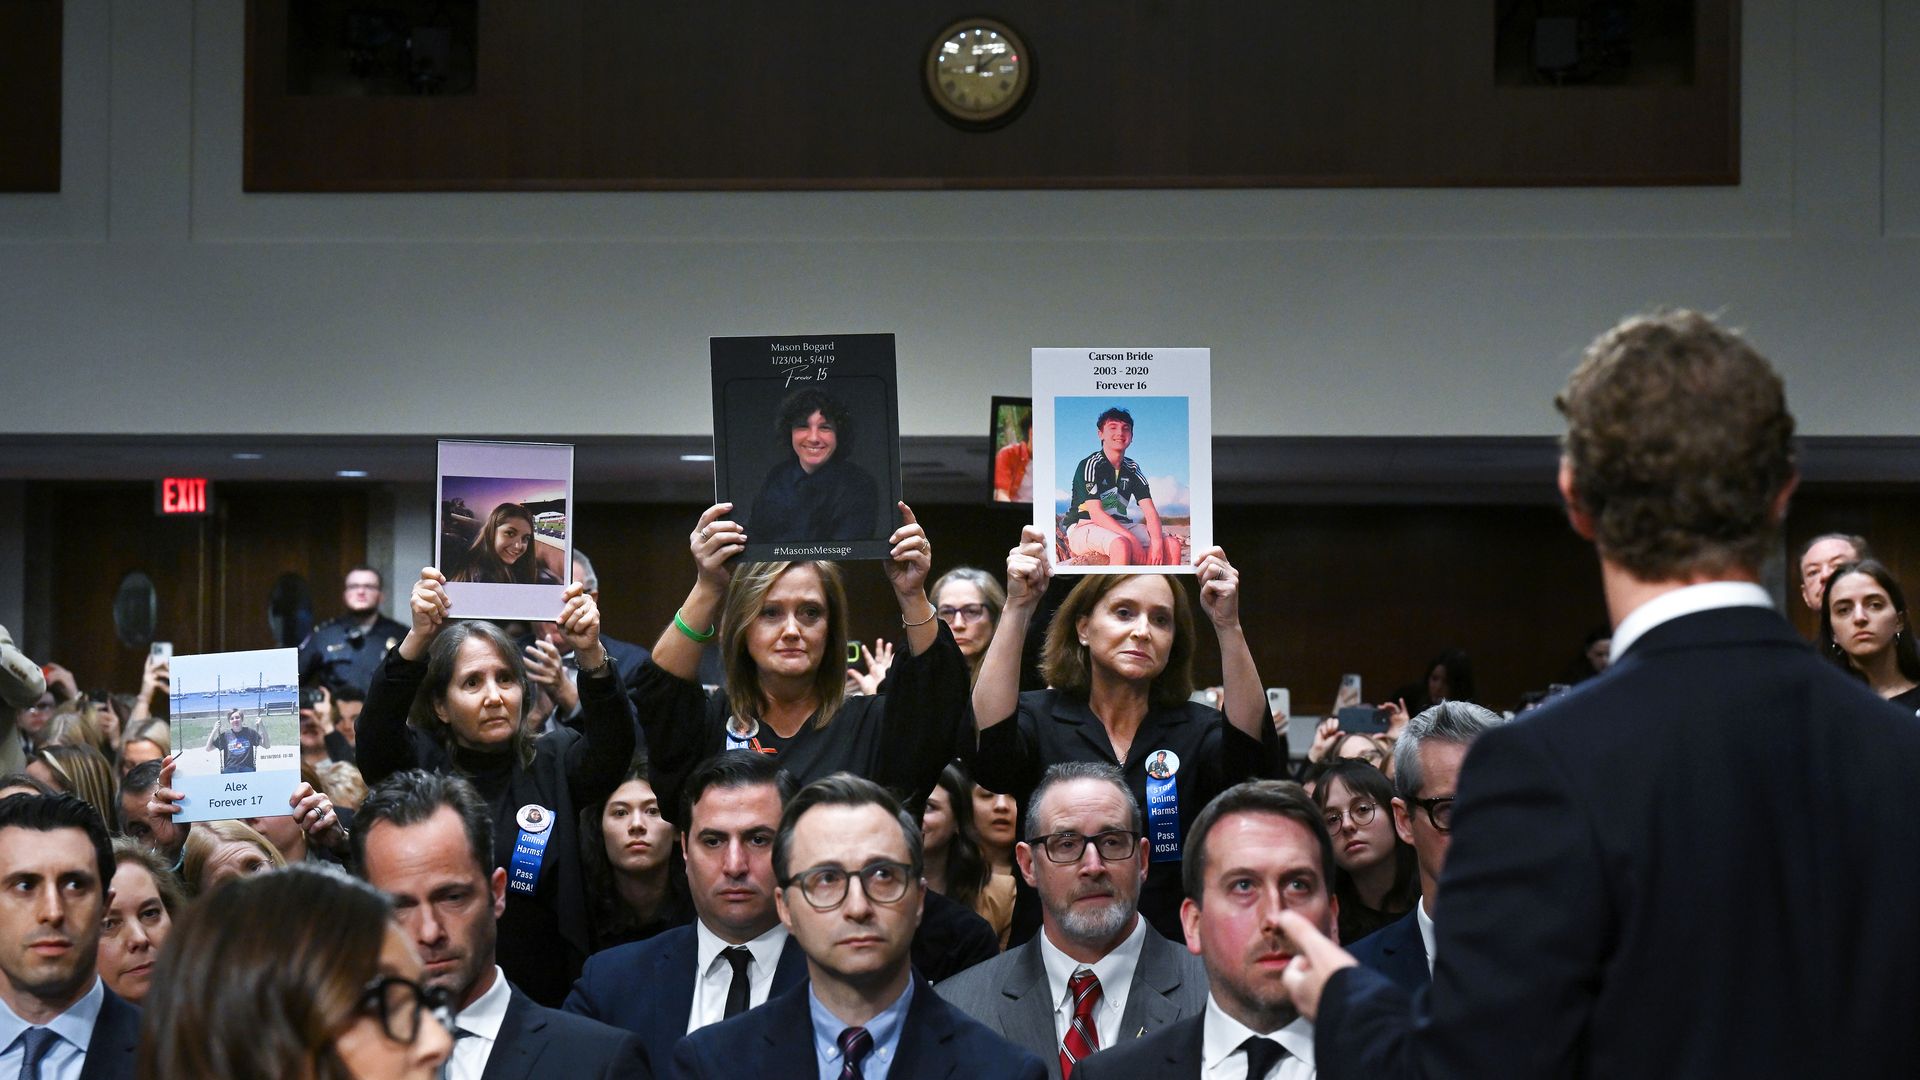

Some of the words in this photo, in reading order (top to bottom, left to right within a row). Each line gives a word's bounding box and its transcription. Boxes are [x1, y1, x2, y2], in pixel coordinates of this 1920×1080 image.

[770, 343, 801, 352] Mason
[803, 342, 835, 353] Bogard
[771, 356, 802, 365] 1/23/04
[809, 355, 835, 364] 5/4/19
[1088, 352, 1124, 361] Carson
[1126, 352, 1154, 361] Bride
[1093, 366, 1117, 375] 2003
[1125, 366, 1149, 375] 2020
[781, 364, 813, 389] Forever
[816, 367, 829, 381] 15
[1095, 381, 1135, 390] Forever
[1137, 381, 1147, 390] 16
[163, 477, 207, 513] EXIT
[773, 546, 852, 557] #MasonsMessage
[224, 782, 248, 792] Alex
[1153, 783, 1173, 794] STOP
[209, 797, 248, 808] Forever
[251, 795, 264, 806] 17
[1151, 794, 1176, 804] Online
[1151, 805, 1178, 816] Harms!
[521, 834, 545, 846] Online
[1157, 831, 1175, 840] Pass
[516, 844, 544, 857] Harms!
[1155, 842, 1178, 853] KOSA!
[515, 868, 533, 880] Pass
[510, 880, 534, 892] KOSA!
